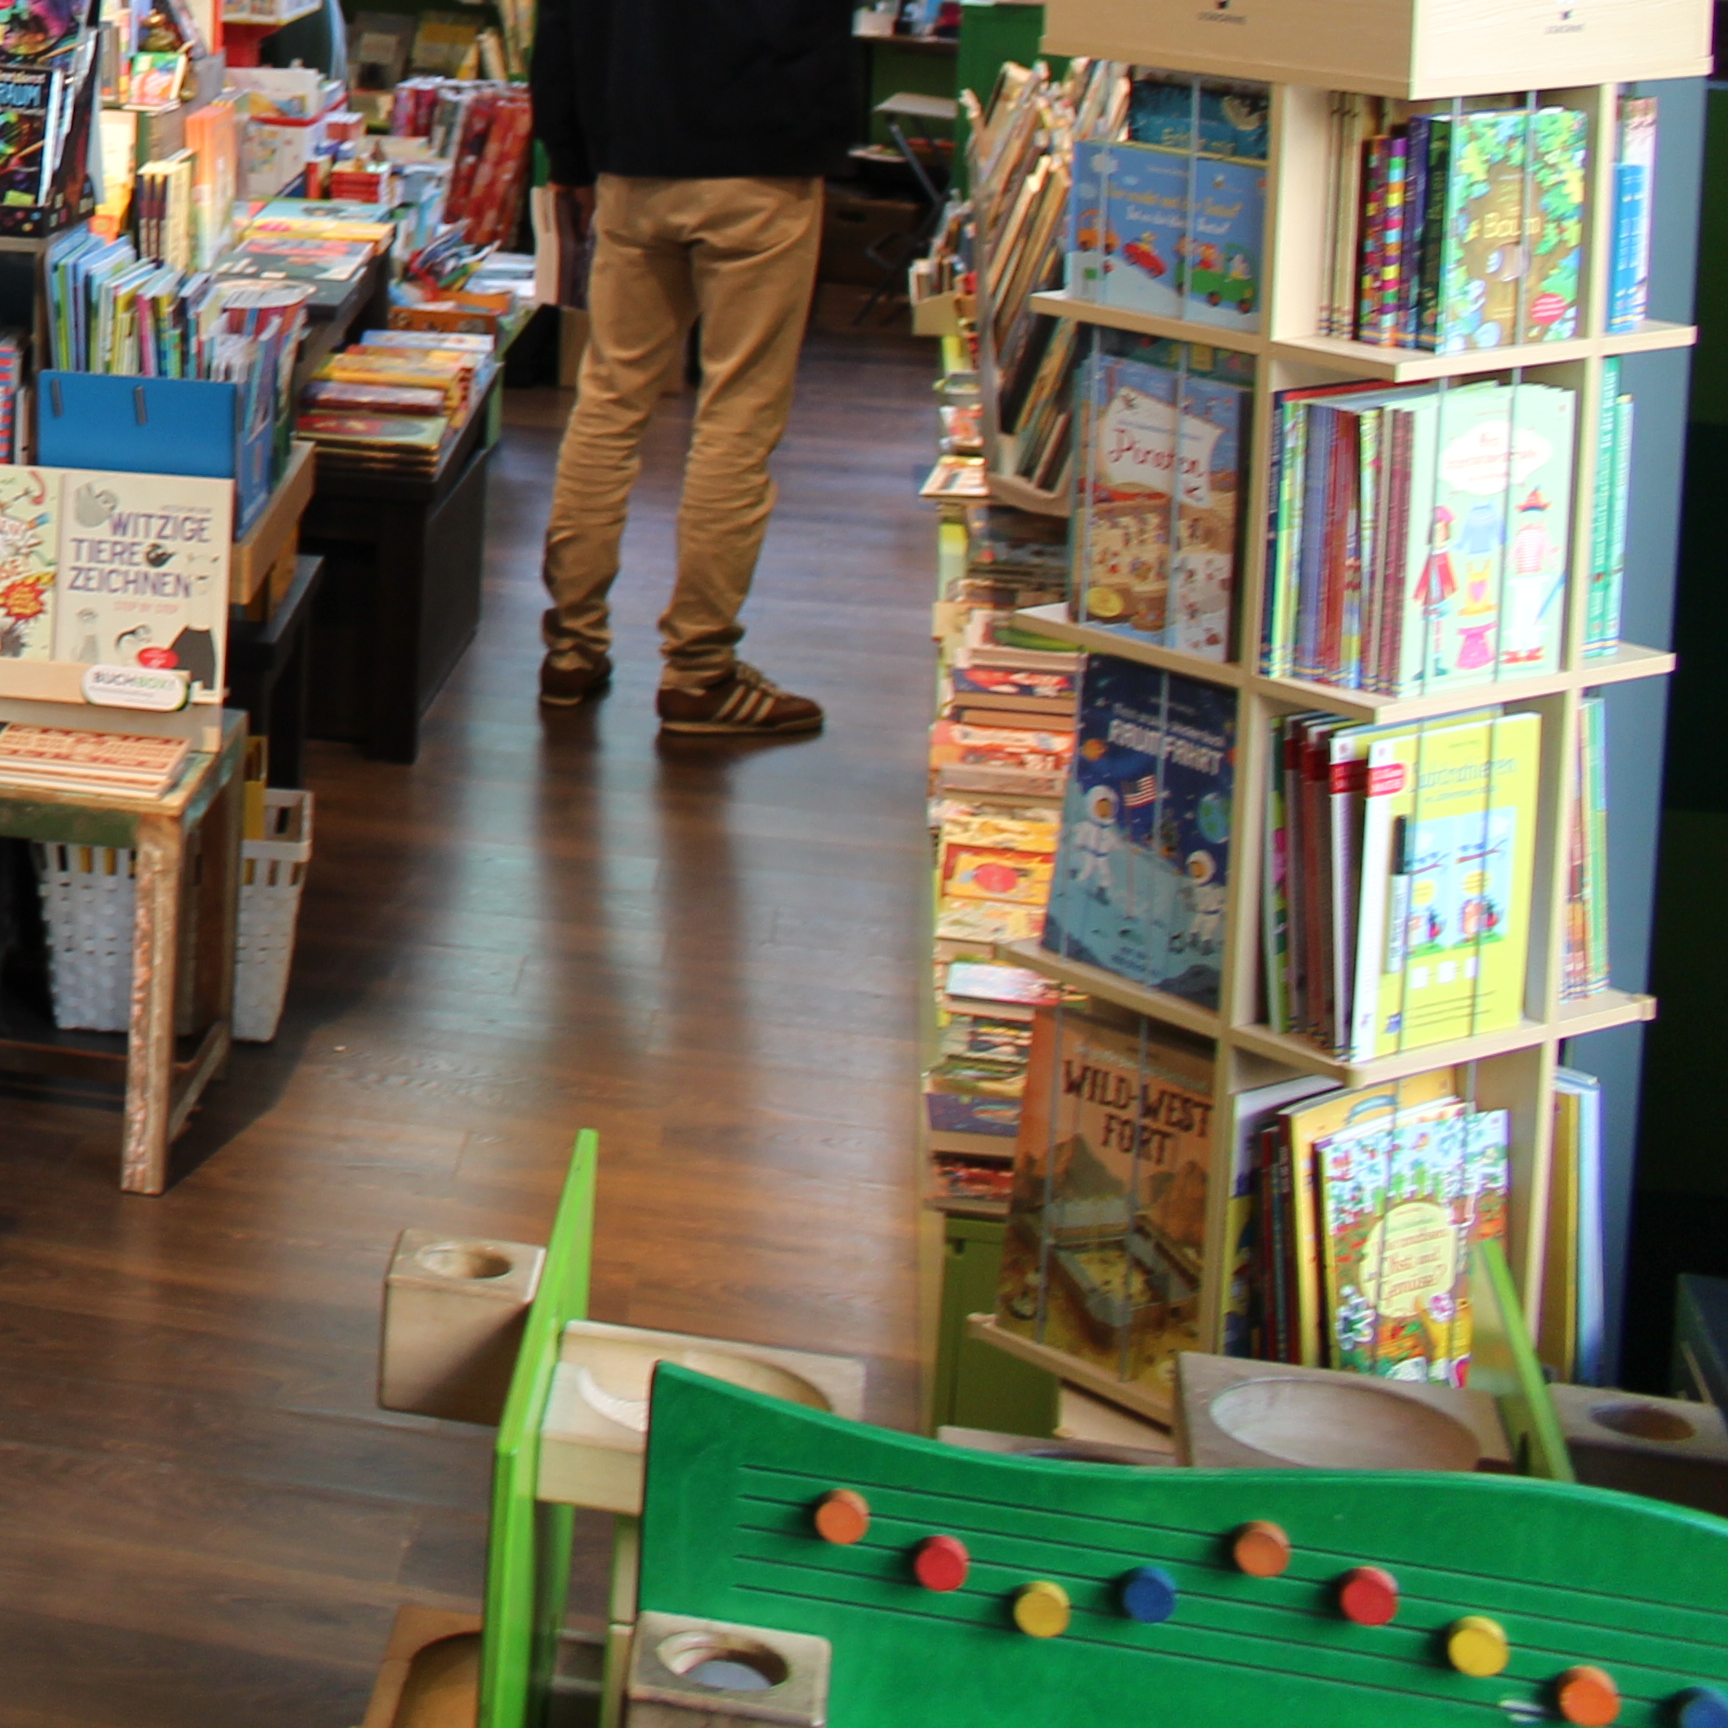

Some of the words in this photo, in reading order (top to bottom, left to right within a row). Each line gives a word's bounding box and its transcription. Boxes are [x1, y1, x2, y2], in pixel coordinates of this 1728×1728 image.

[109, 512, 212, 544] WITZIGE
[70, 538, 142, 567] TIERE
[68, 567, 192, 598] ZEICHNEN
[1102, 1113, 1173, 1165] FORT
